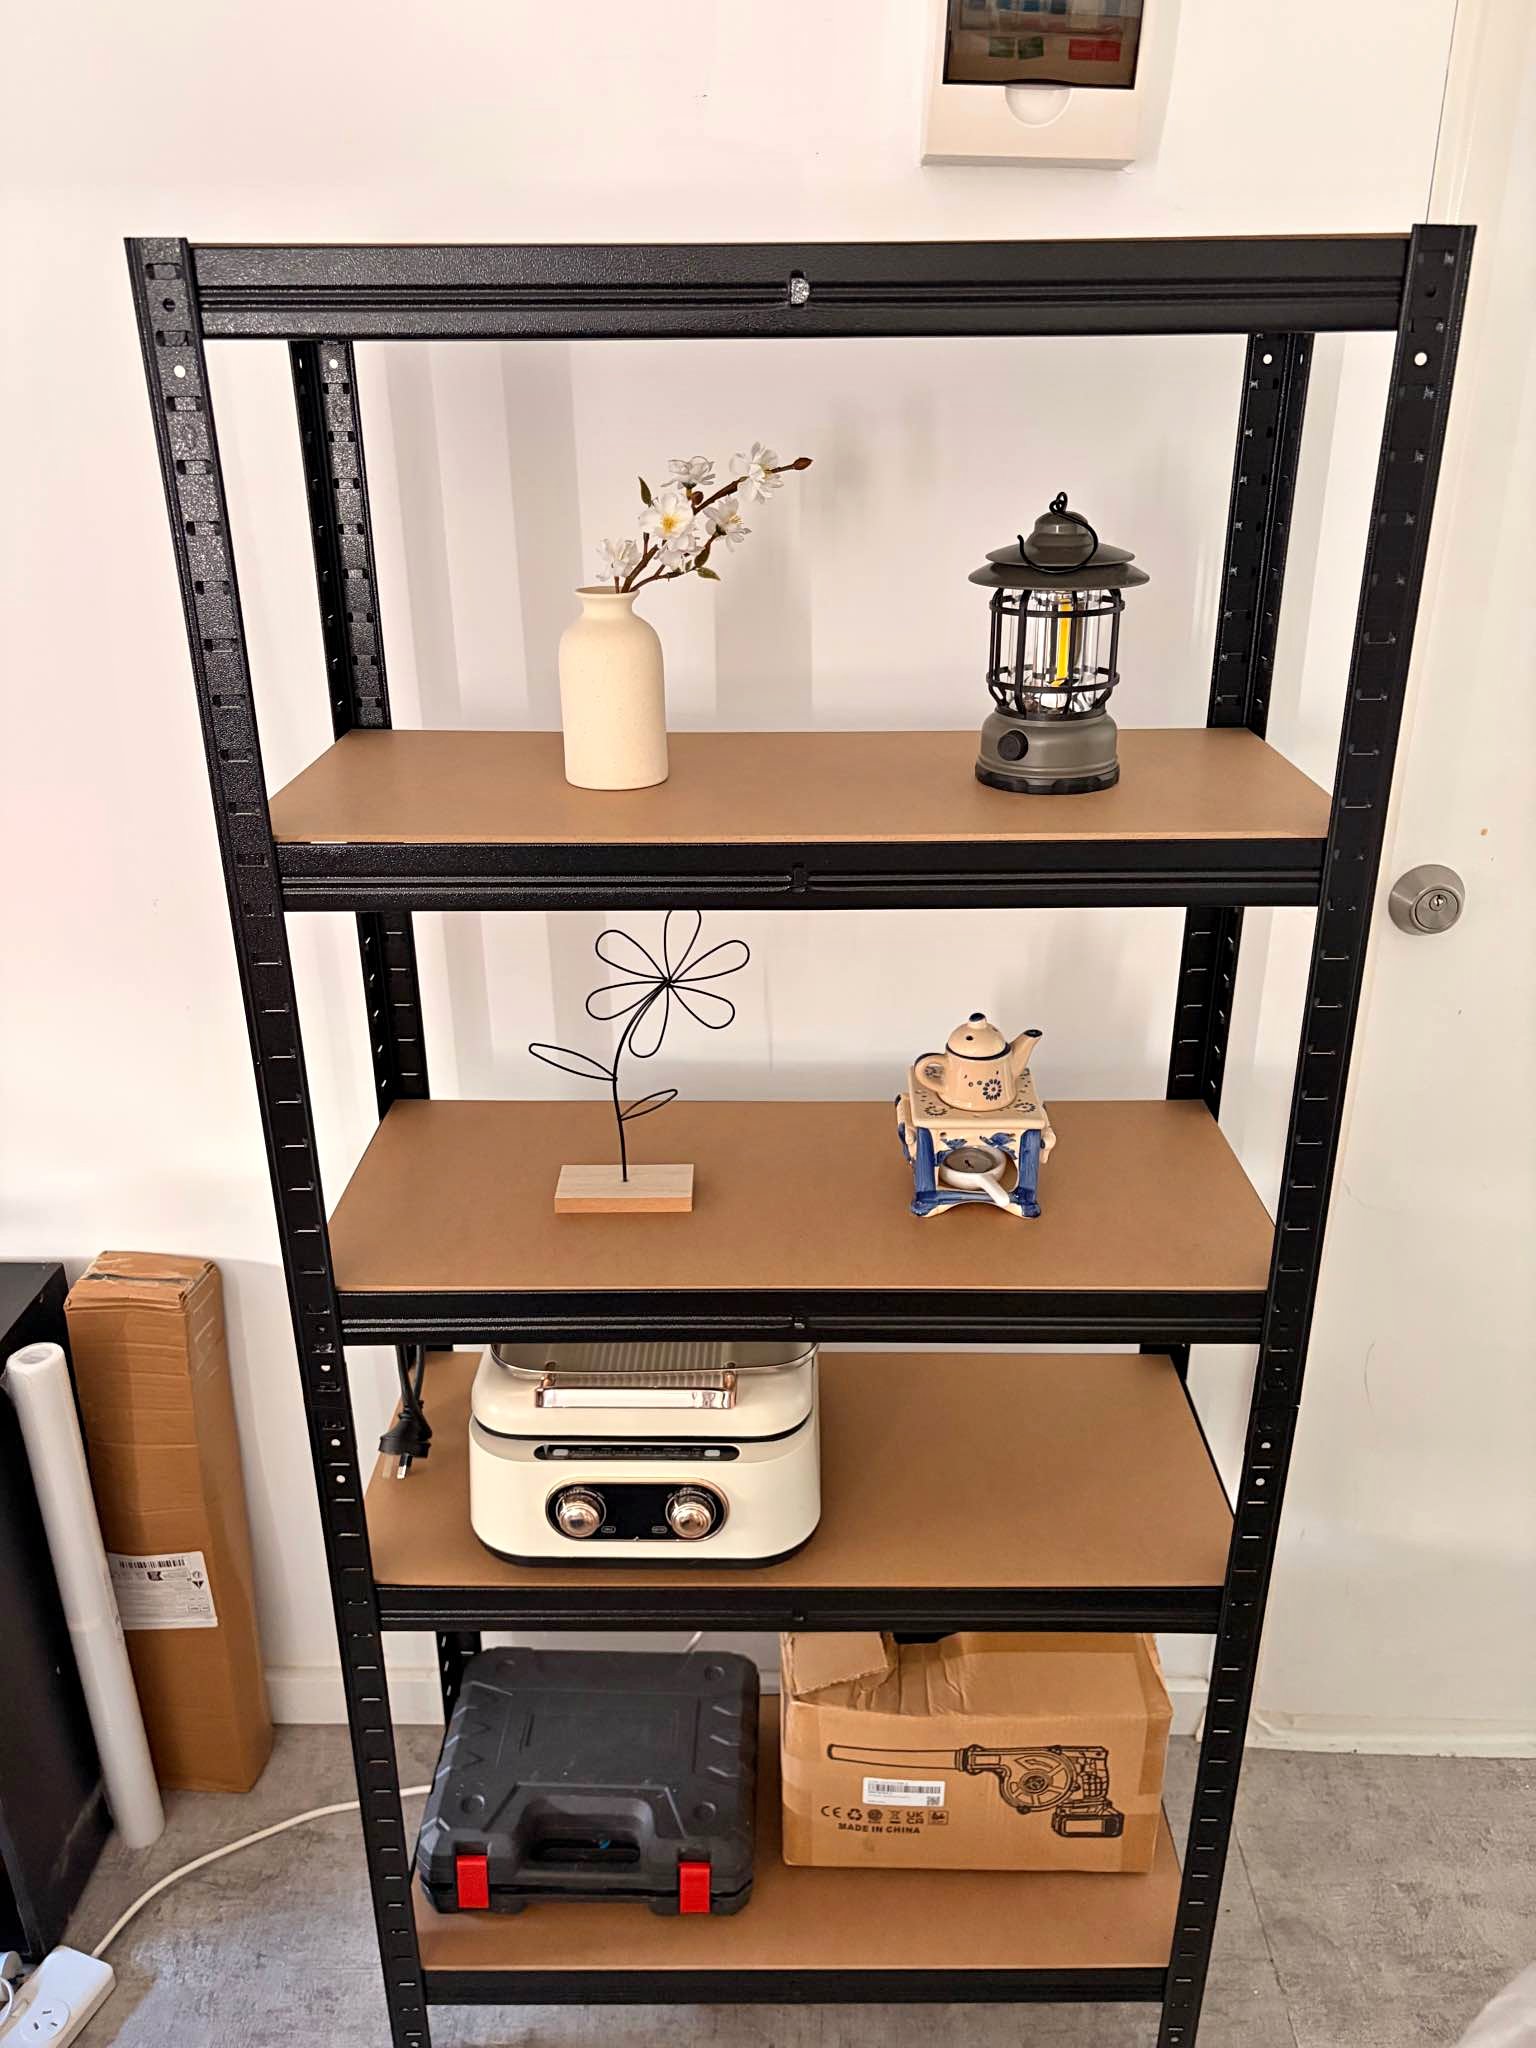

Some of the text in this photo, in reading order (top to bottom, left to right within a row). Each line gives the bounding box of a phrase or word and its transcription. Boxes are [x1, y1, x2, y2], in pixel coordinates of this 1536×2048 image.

[838, 1822, 869, 1832] MADE
[871, 1825, 883, 1833] IN
[886, 1826, 921, 1834] CHINA
